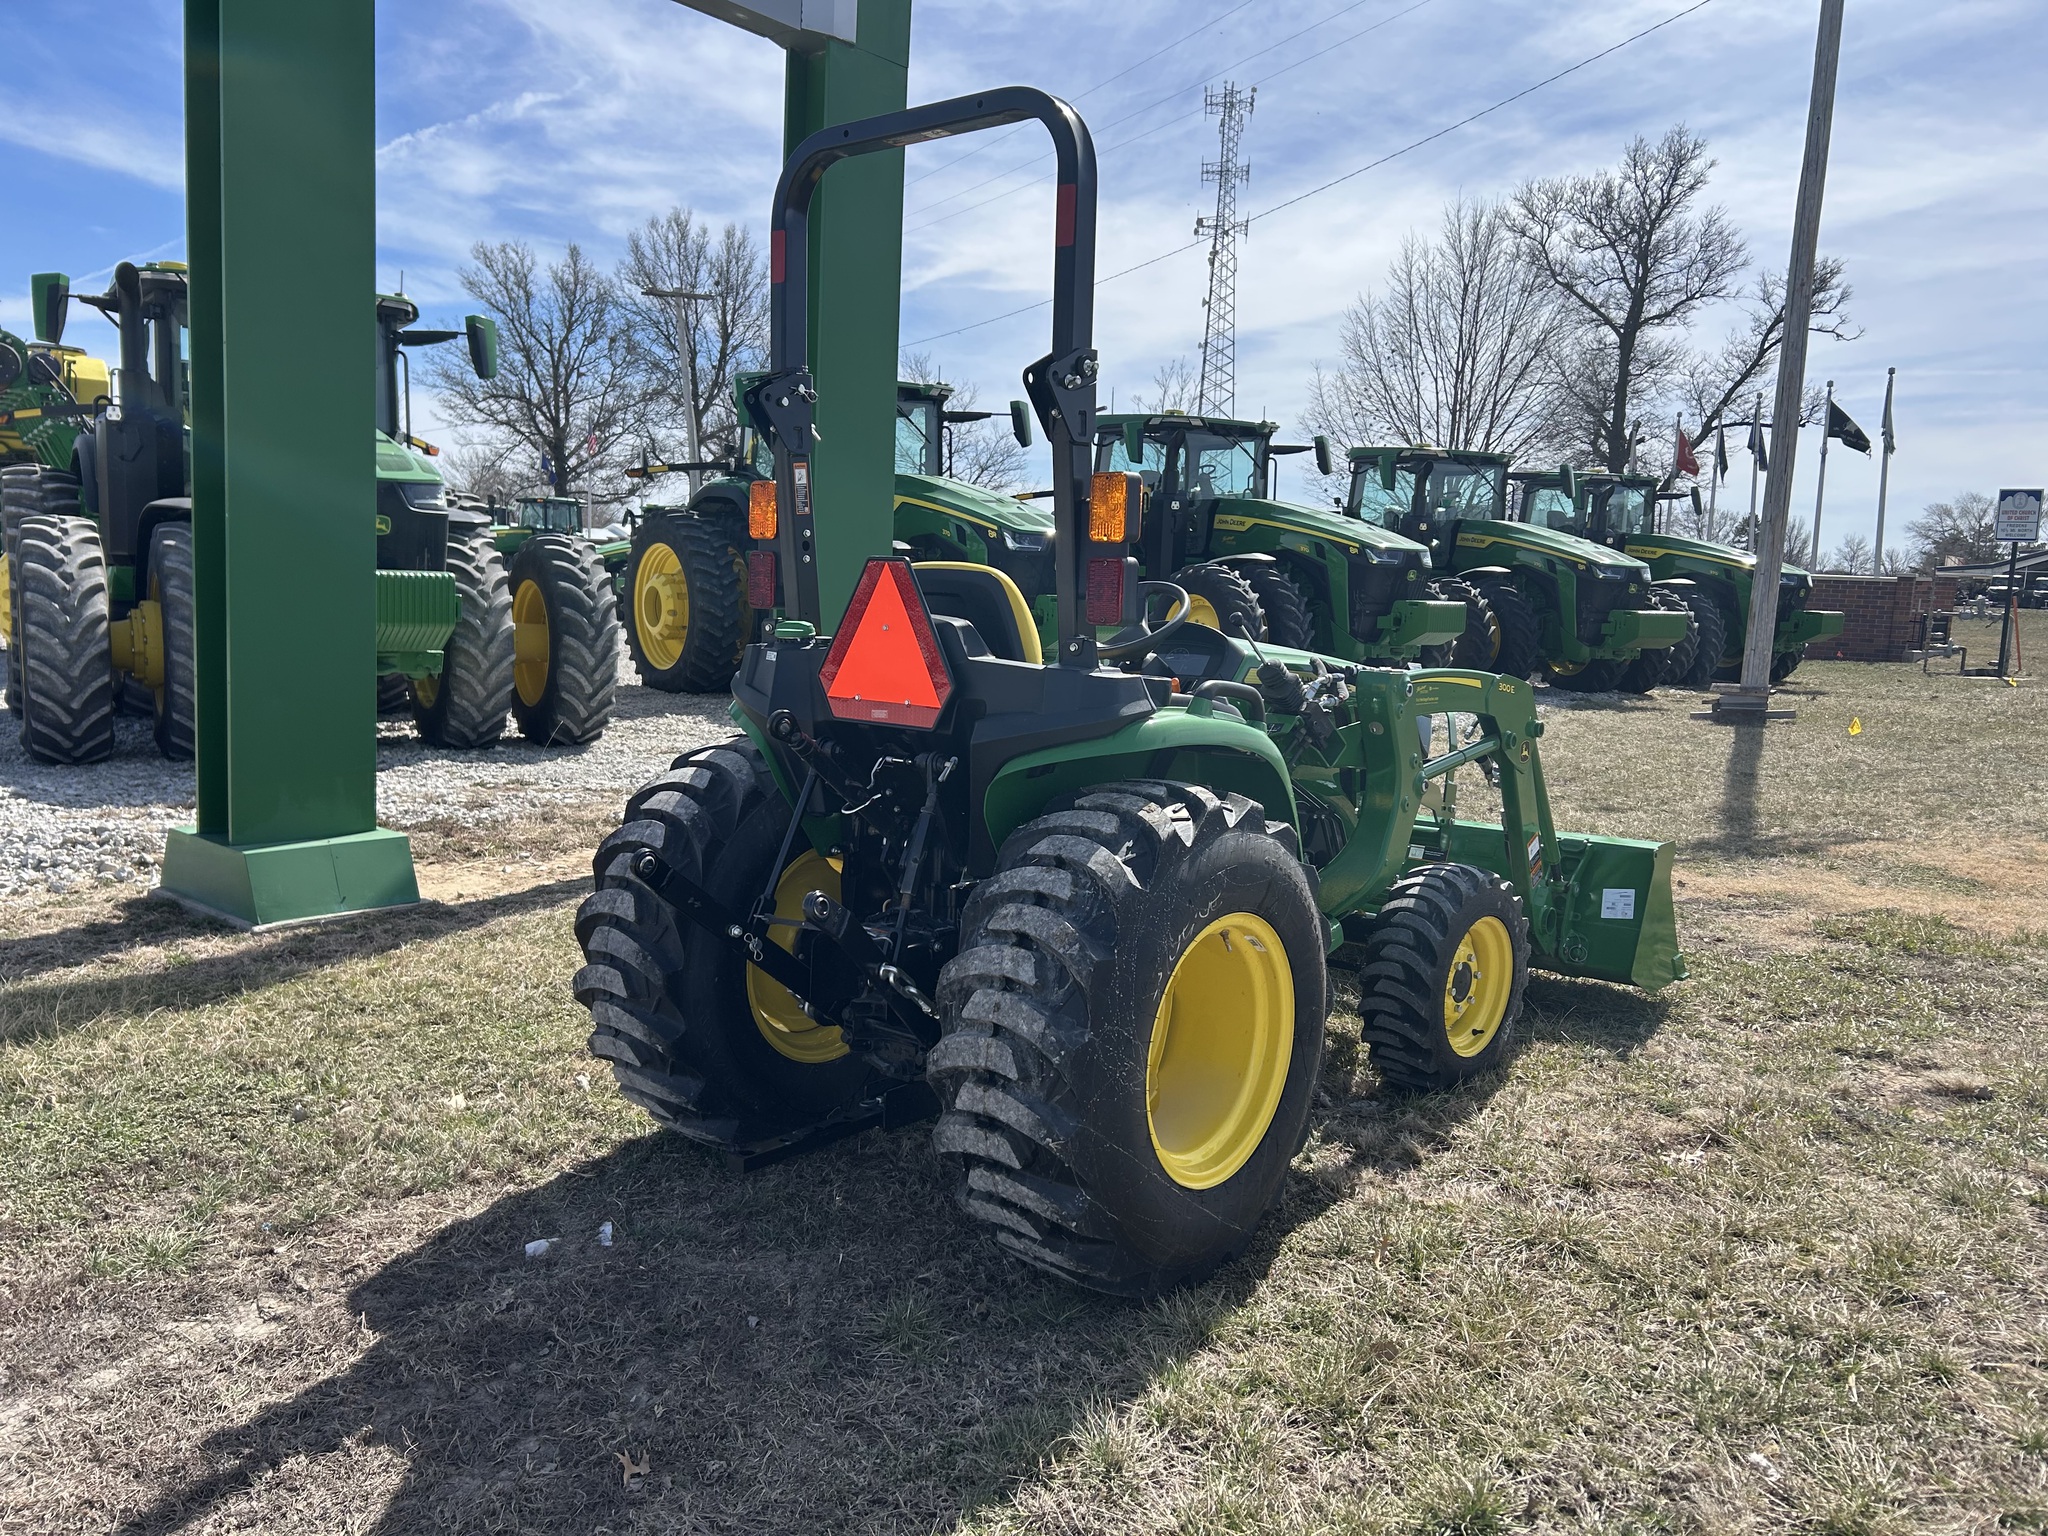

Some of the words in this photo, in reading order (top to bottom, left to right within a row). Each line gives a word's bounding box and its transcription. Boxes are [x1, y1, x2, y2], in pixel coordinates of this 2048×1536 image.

[1229, 518, 1246, 527] DEERE
[988, 529, 997, 539] 8R
[1471, 537, 1486, 545] DEERE
[1640, 548, 1657, 556] DEERE
[1498, 682, 1515, 694] 300E
